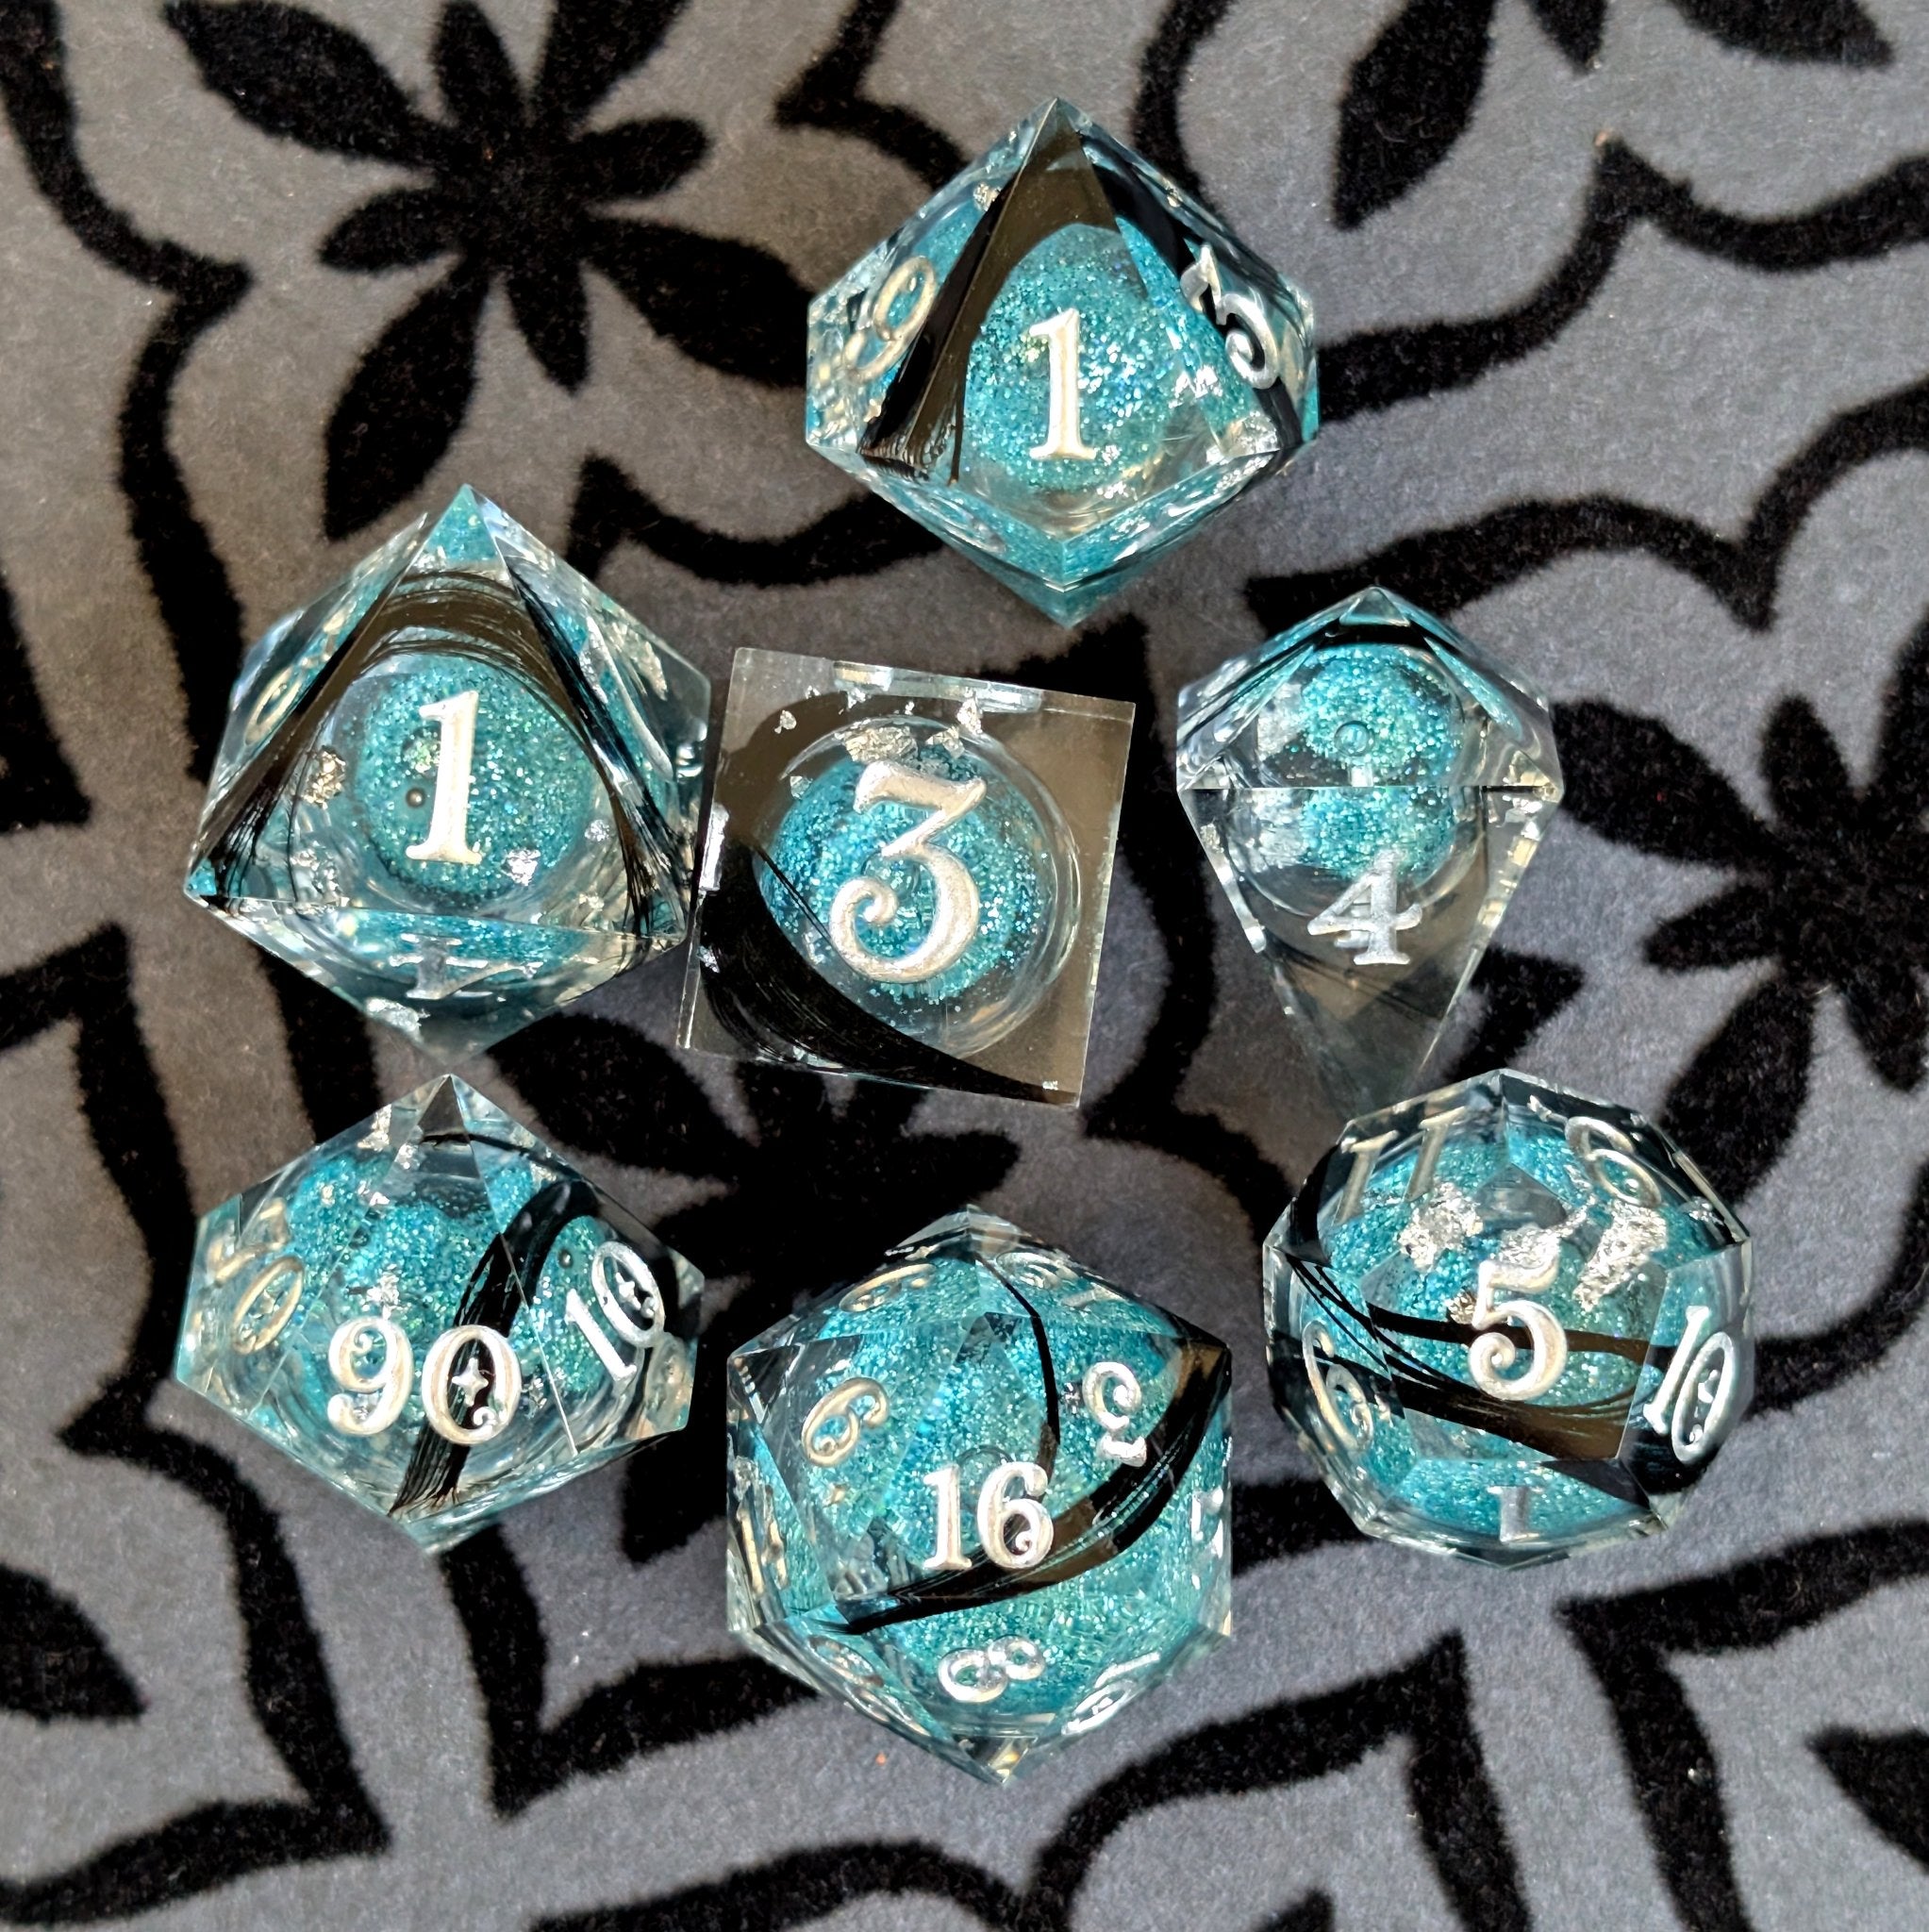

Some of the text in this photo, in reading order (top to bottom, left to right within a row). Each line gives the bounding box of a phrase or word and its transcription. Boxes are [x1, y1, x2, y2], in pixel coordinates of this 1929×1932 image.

[1027, 308, 1097, 461] 1
[1179, 243, 1278, 390] 5
[405, 690, 482, 865] 1
[830, 761, 988, 983] 3
[1307, 849, 1423, 965] 4
[326, 1314, 522, 1445] 90
[565, 1241, 666, 1383] 10
[1468, 1249, 1568, 1401] 5
[1643, 1304, 1736, 1464] 10
[802, 1376, 890, 1467] 6
[923, 1461, 1054, 1570] 16
[938, 1634, 1045, 1703] 8
